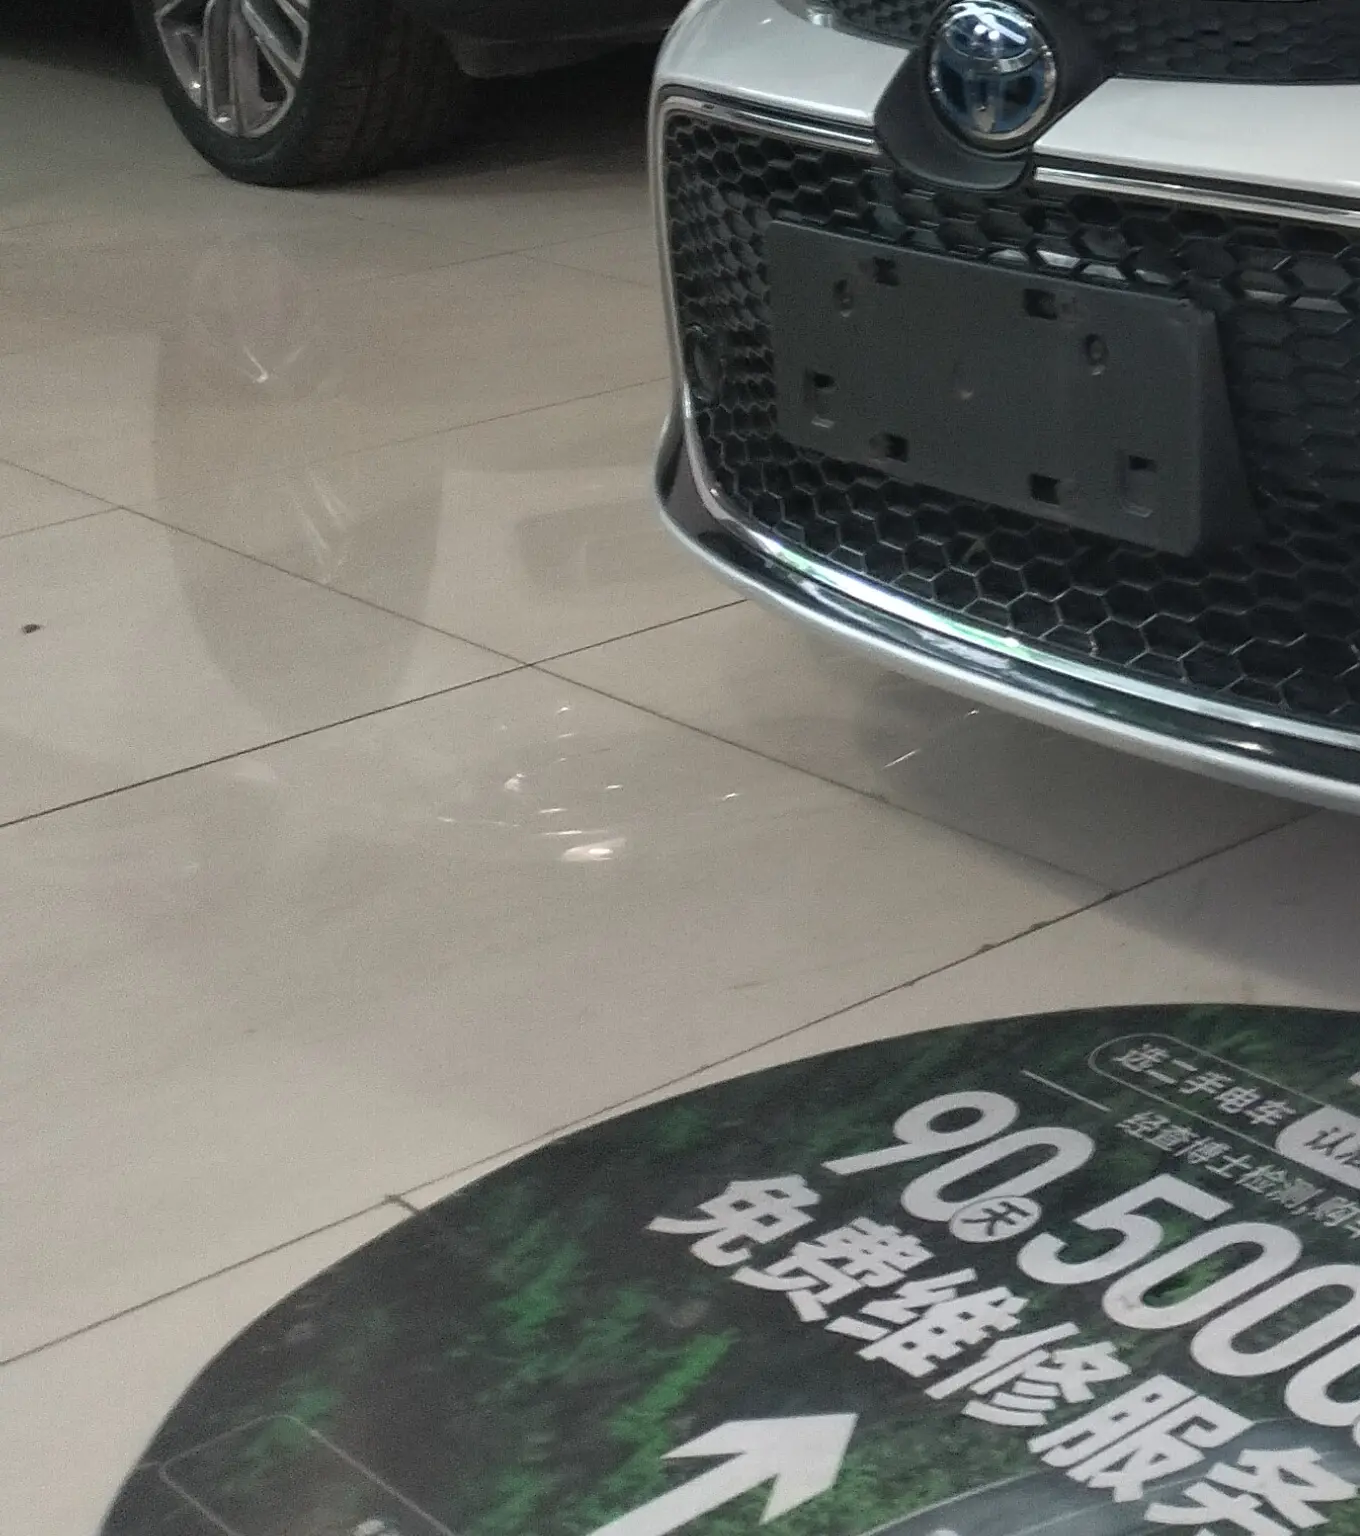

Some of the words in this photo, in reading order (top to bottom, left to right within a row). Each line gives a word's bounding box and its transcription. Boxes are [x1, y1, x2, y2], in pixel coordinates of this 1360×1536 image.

[1112, 1042, 1297, 1128] 选二手电车
[646, 1173, 1359, 1536] 免费维修服务
